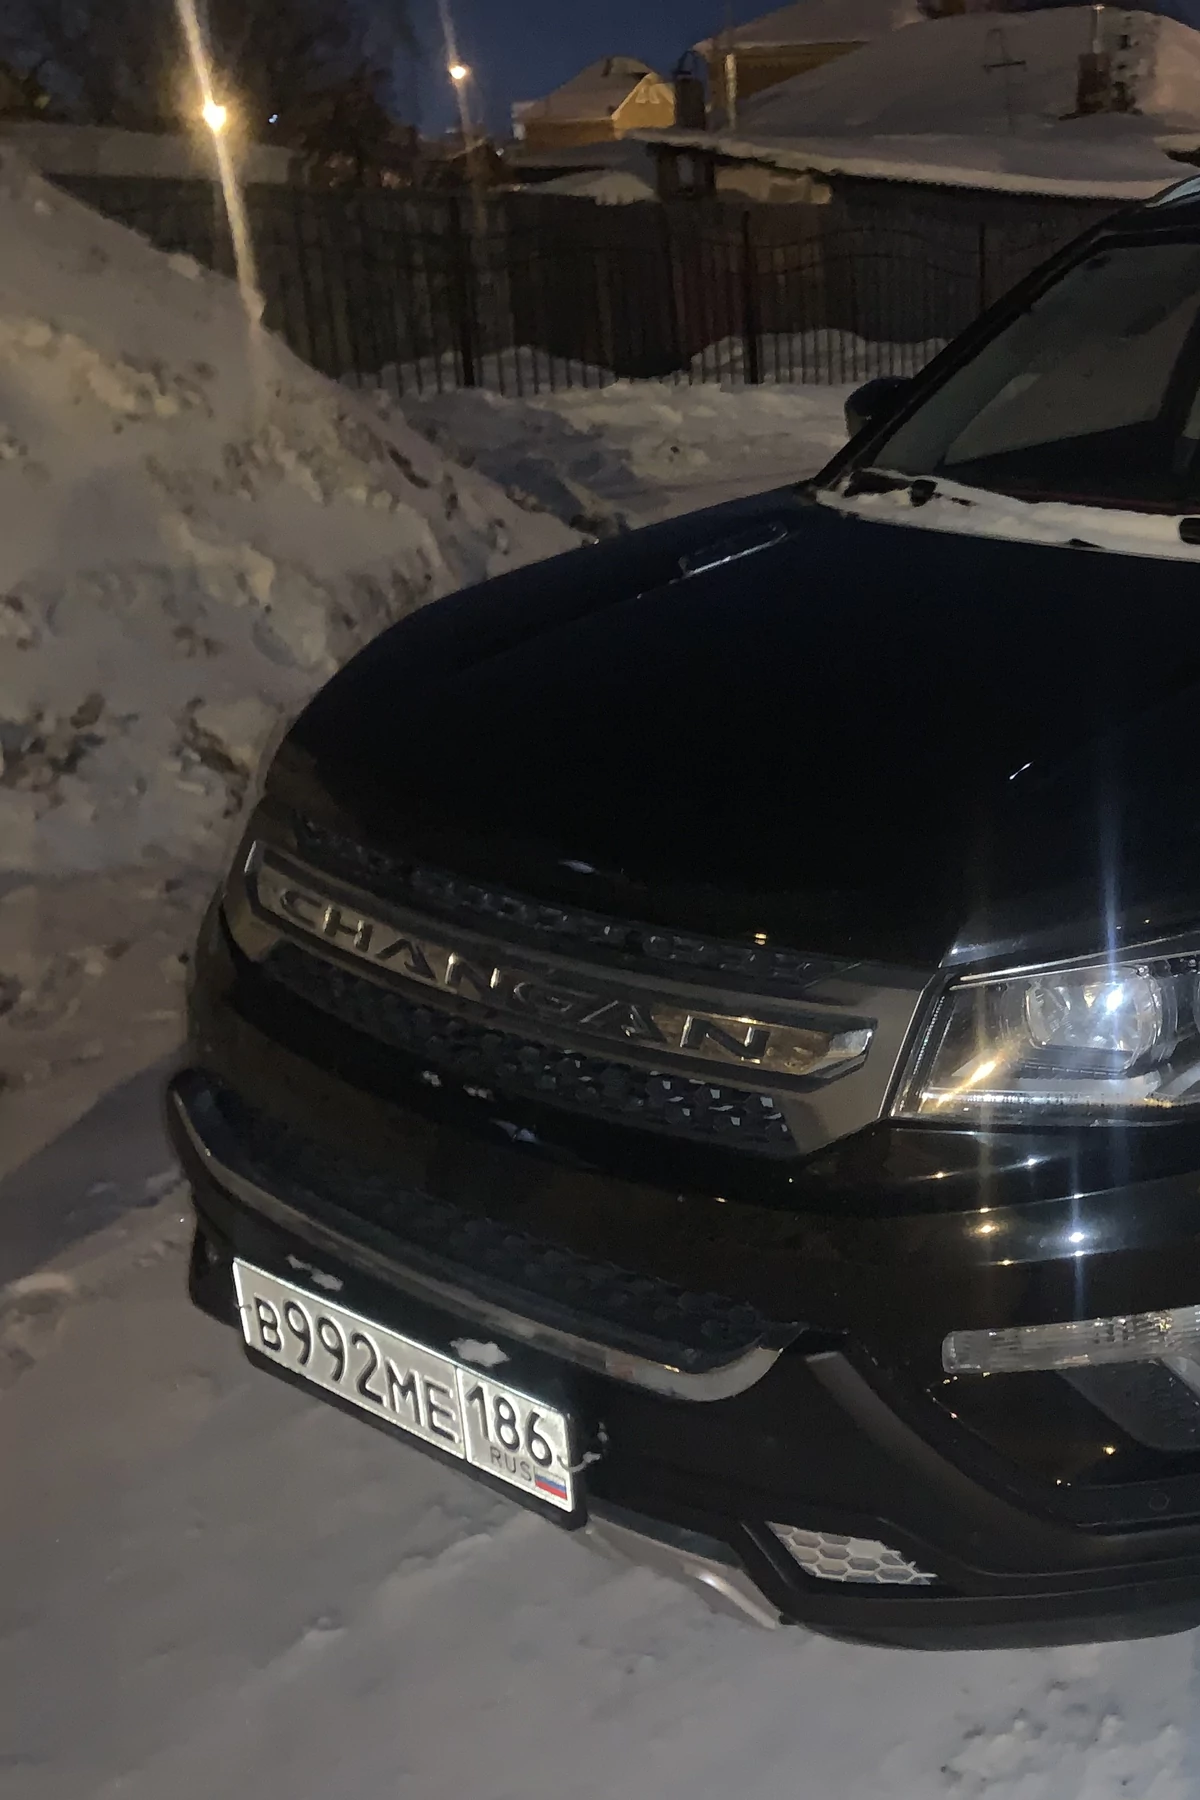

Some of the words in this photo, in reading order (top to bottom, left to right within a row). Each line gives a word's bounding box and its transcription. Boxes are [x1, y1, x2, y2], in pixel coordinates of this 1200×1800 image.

[279, 890, 771, 1064] CHANGAN
[467, 1386, 554, 1467] 186
[489, 1445, 532, 1483] RUS
